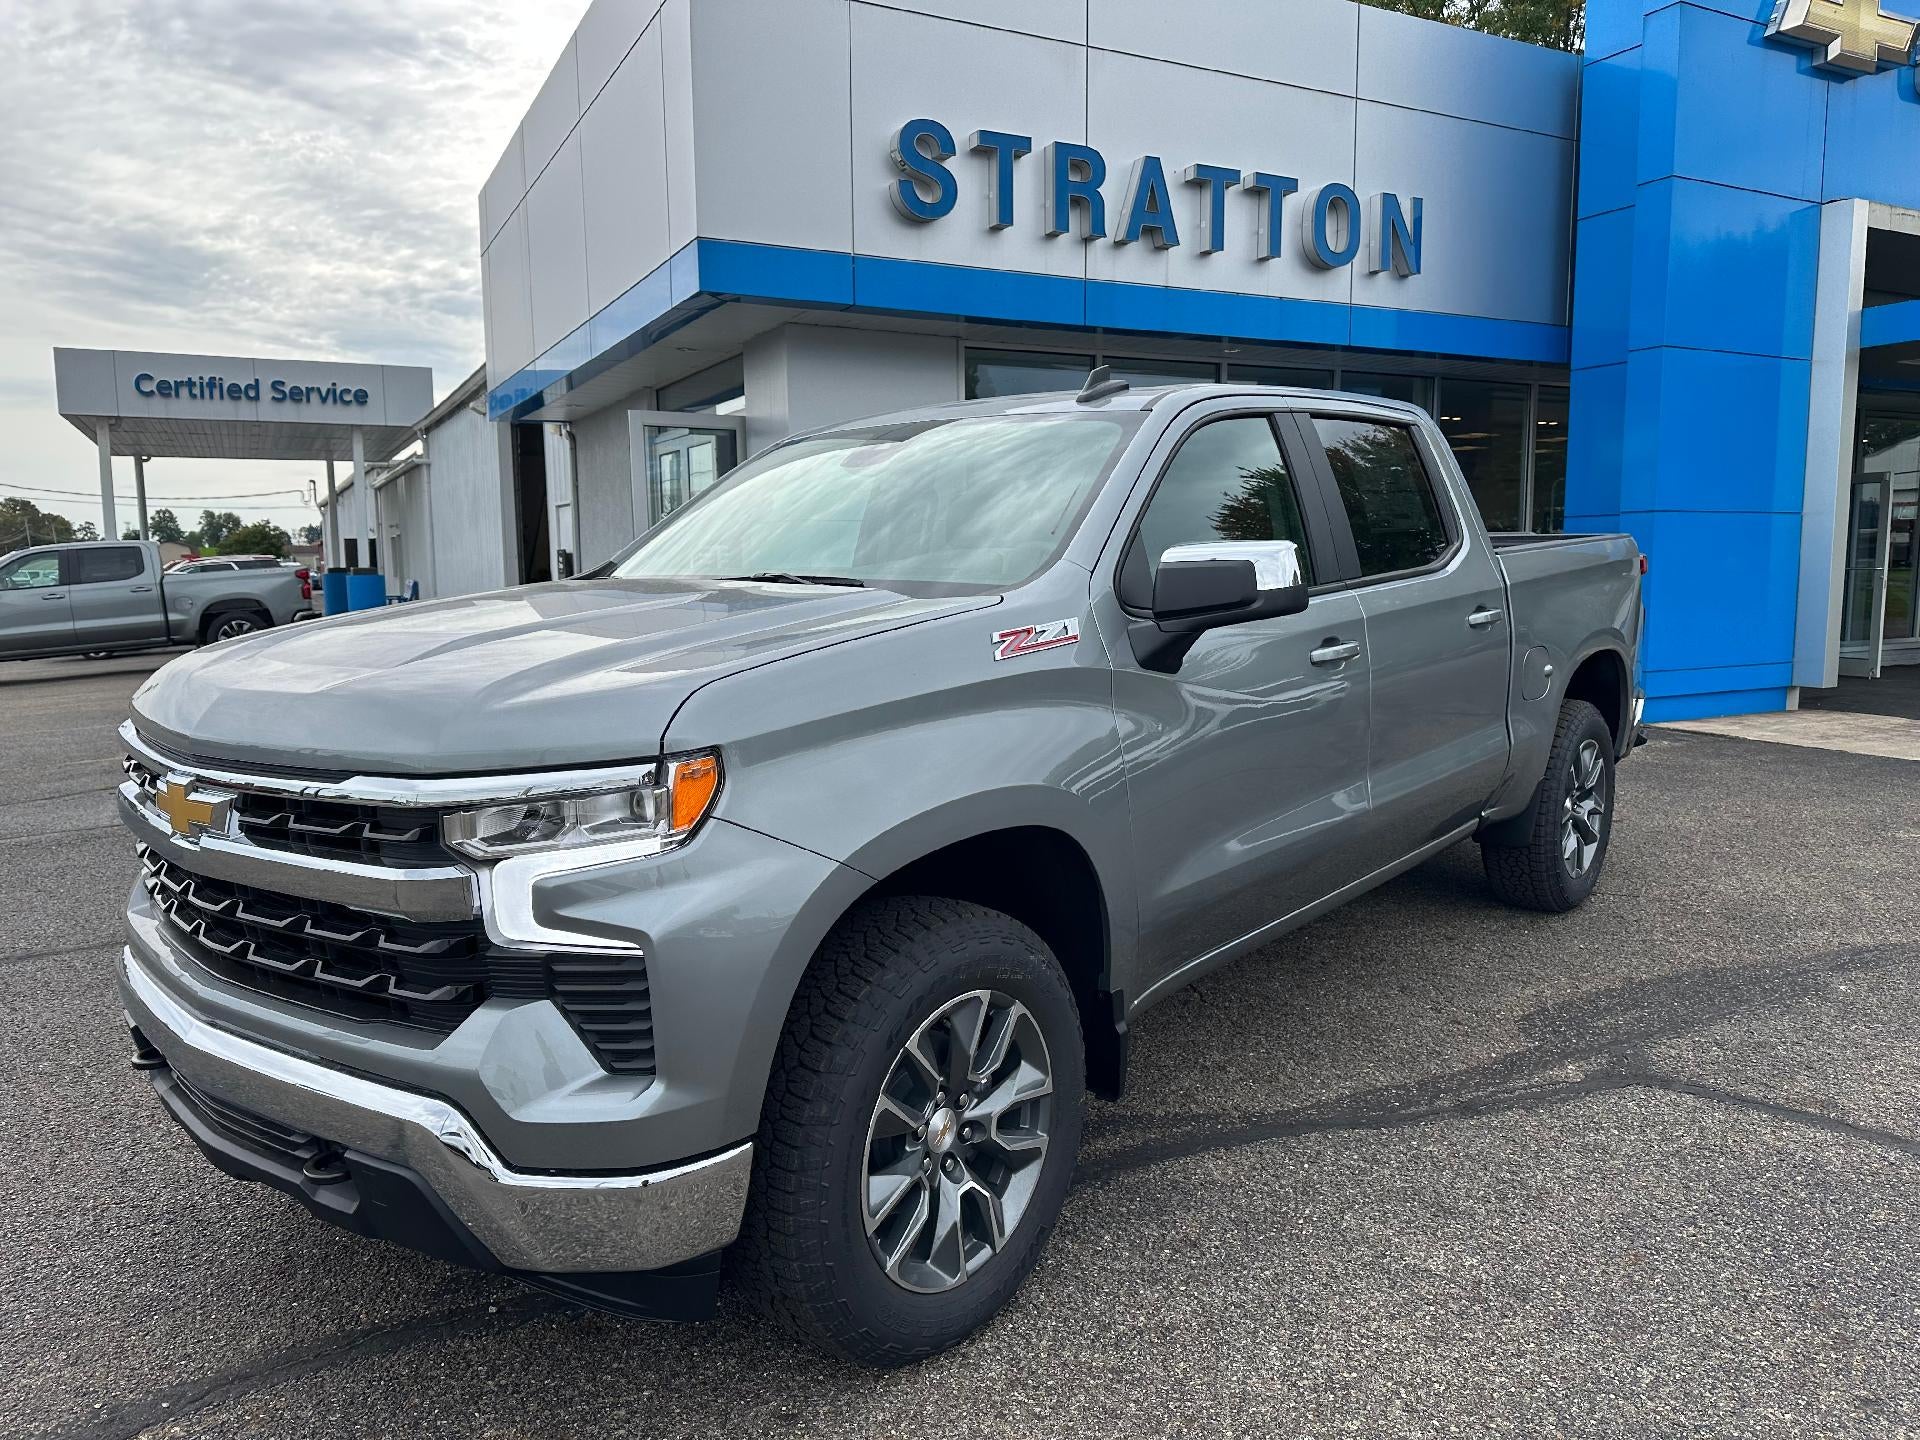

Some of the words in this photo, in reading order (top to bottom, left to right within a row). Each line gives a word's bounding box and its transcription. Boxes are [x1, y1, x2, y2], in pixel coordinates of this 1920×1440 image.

[889, 118, 1423, 278] STRATTON
[134, 372, 260, 402] Certified
[271, 379, 369, 405] Service
[990, 617, 1080, 661] Z71
